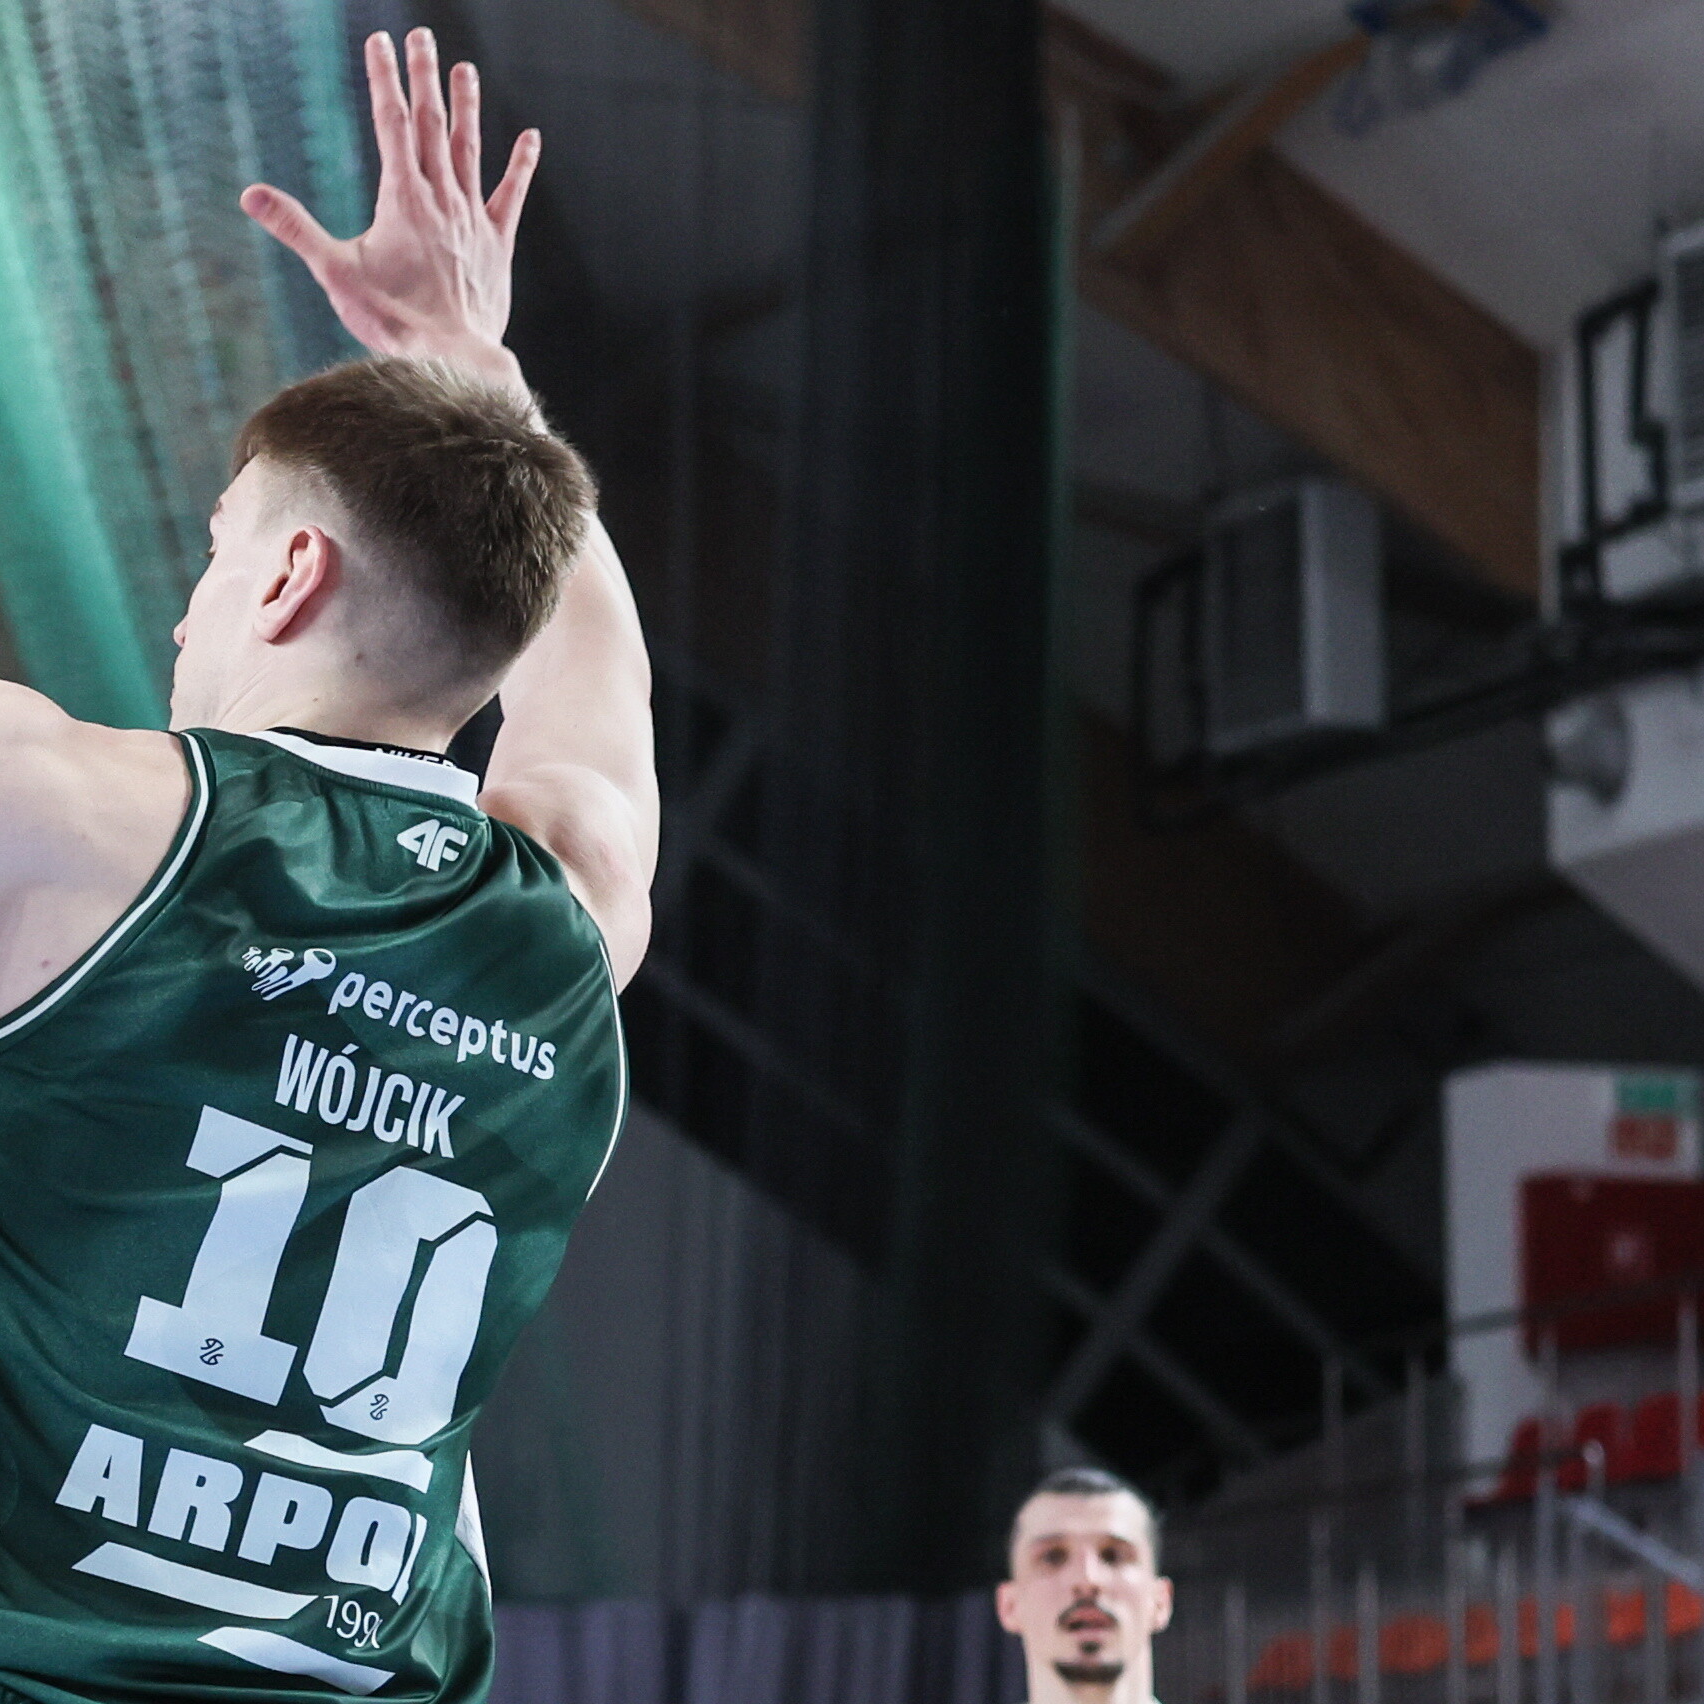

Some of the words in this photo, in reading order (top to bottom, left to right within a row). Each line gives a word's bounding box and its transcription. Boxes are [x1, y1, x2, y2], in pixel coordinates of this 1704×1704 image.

[397, 819, 469, 872] 4F
[327, 971, 558, 1081] perceptus
[274, 1033, 467, 1159] WÓJCIK
[124, 1104, 499, 1445] 10
